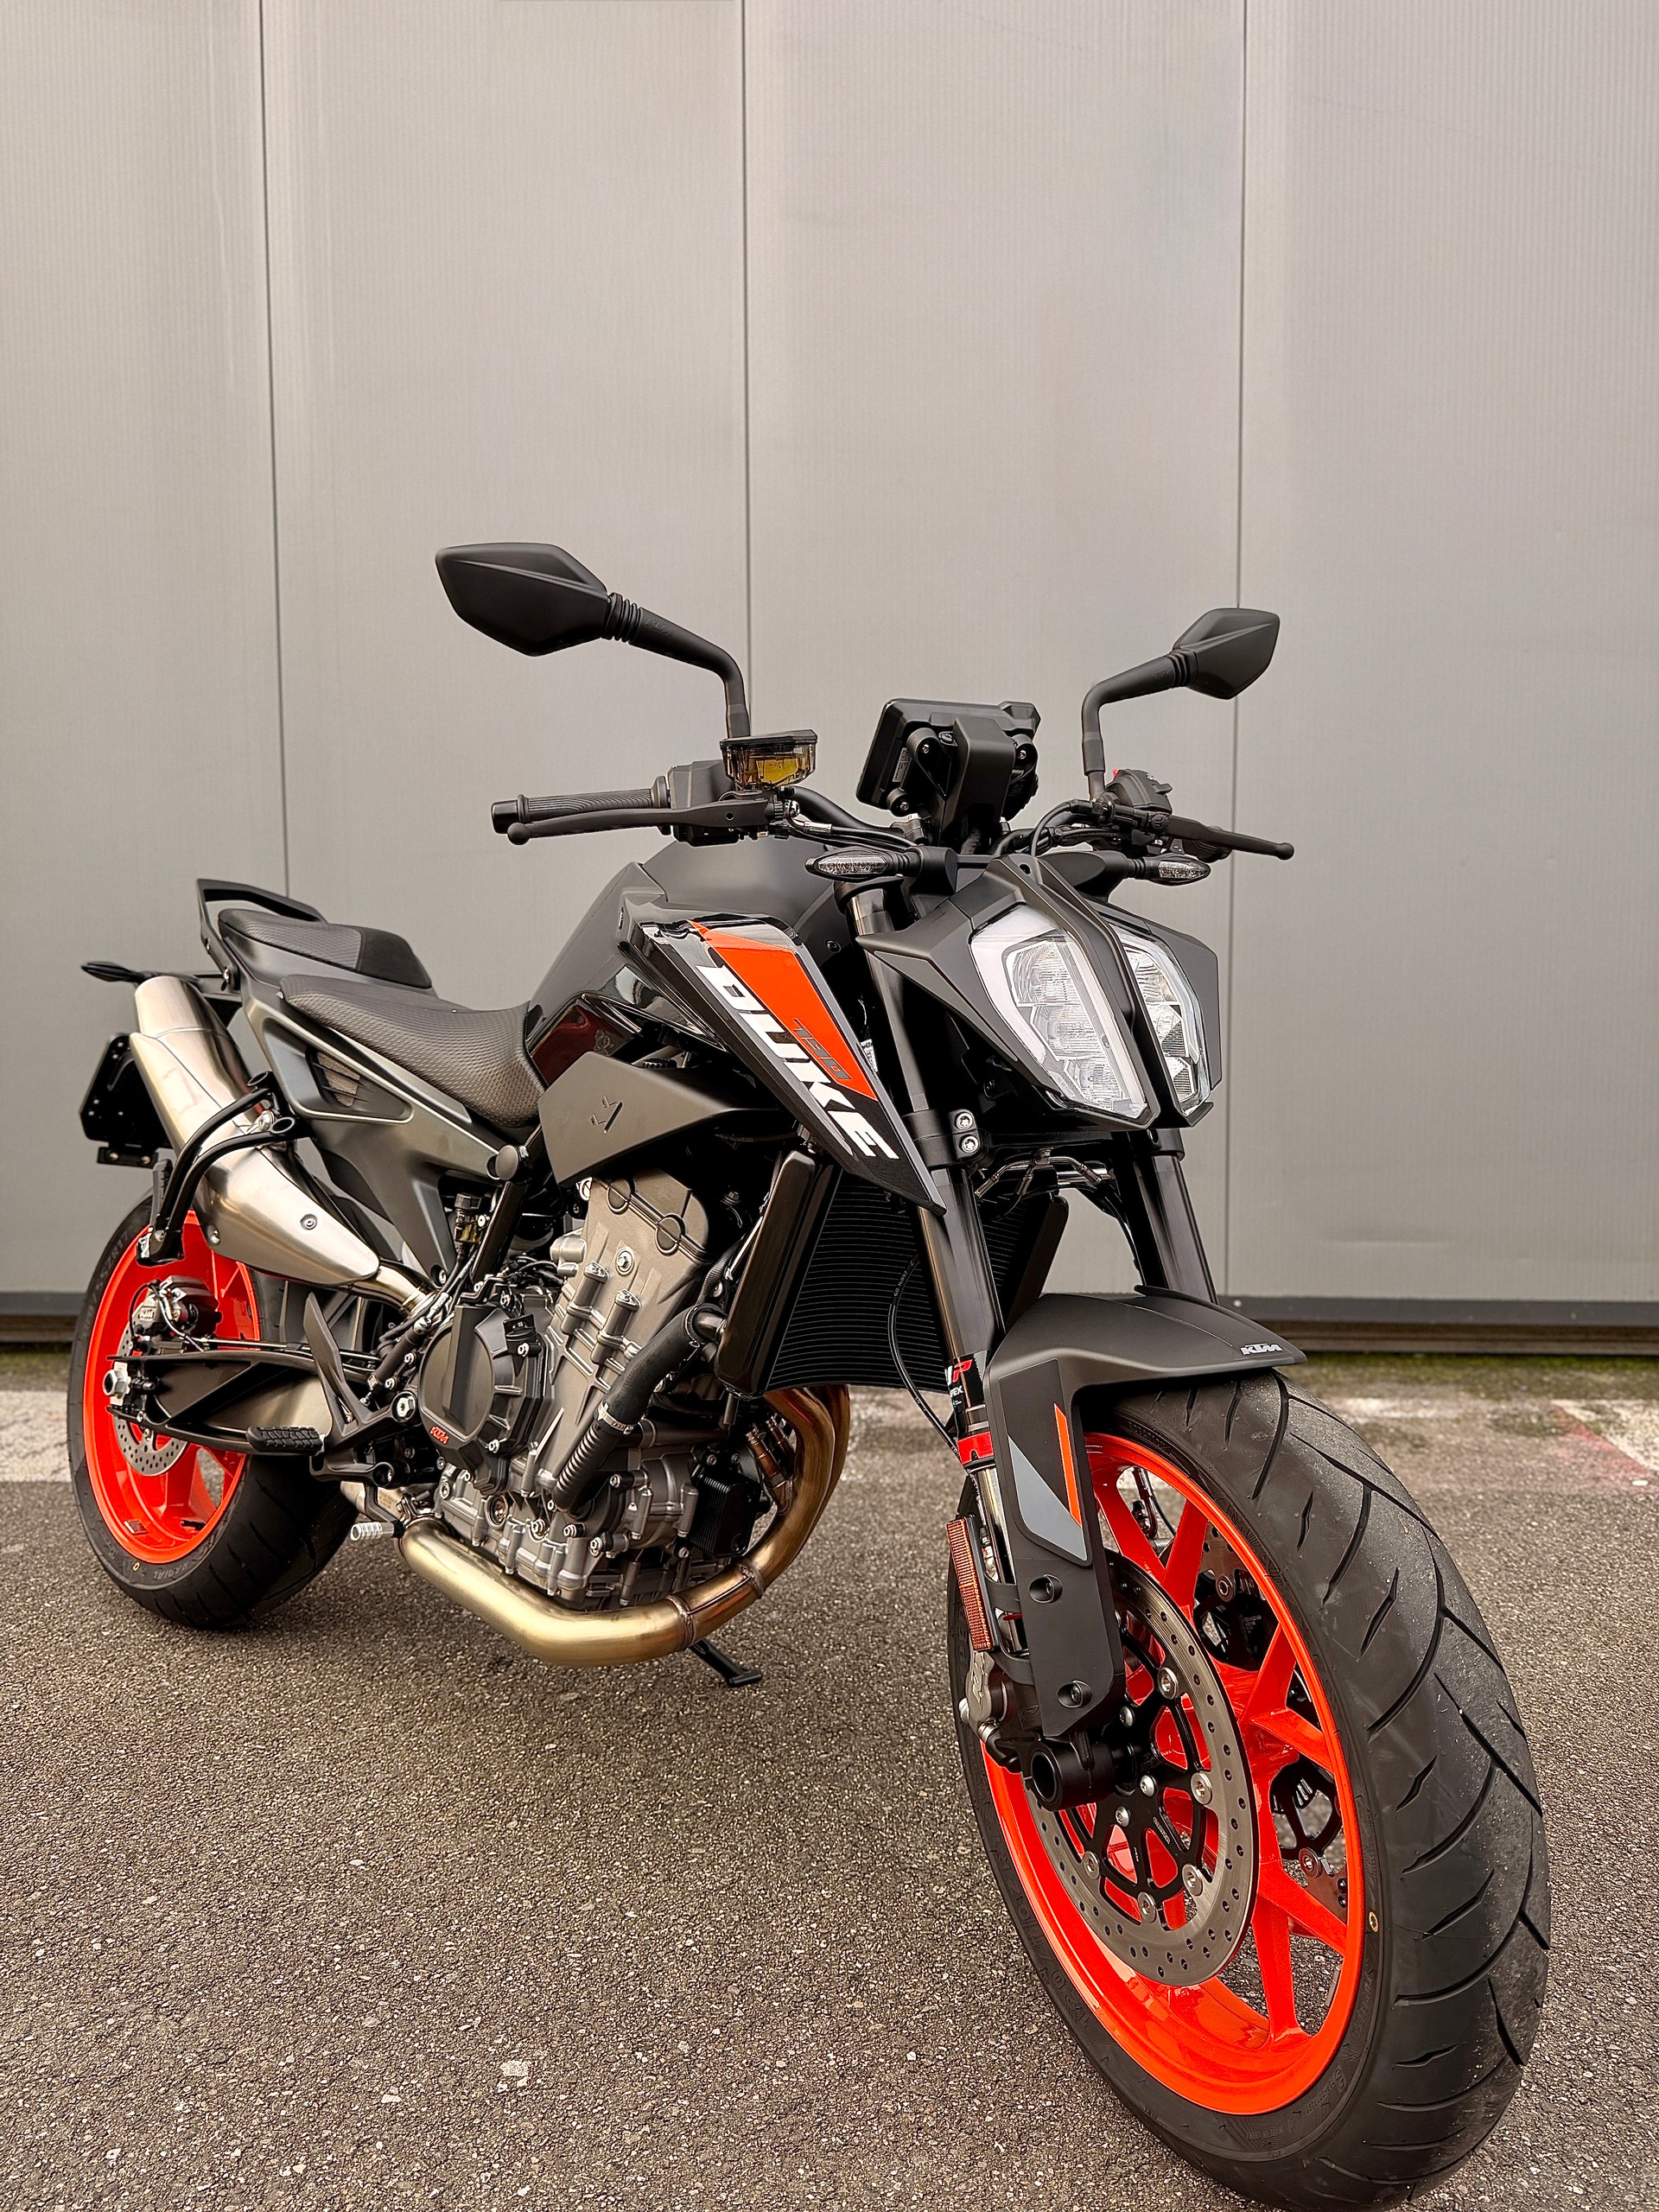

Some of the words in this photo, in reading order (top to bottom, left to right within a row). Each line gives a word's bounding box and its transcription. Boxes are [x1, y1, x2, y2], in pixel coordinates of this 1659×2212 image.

[696, 964, 899, 1160] DUKE
[791, 1017, 852, 1080] 790
[1240, 1343, 1283, 1356] KTM
[429, 1426, 449, 1444] KTM
